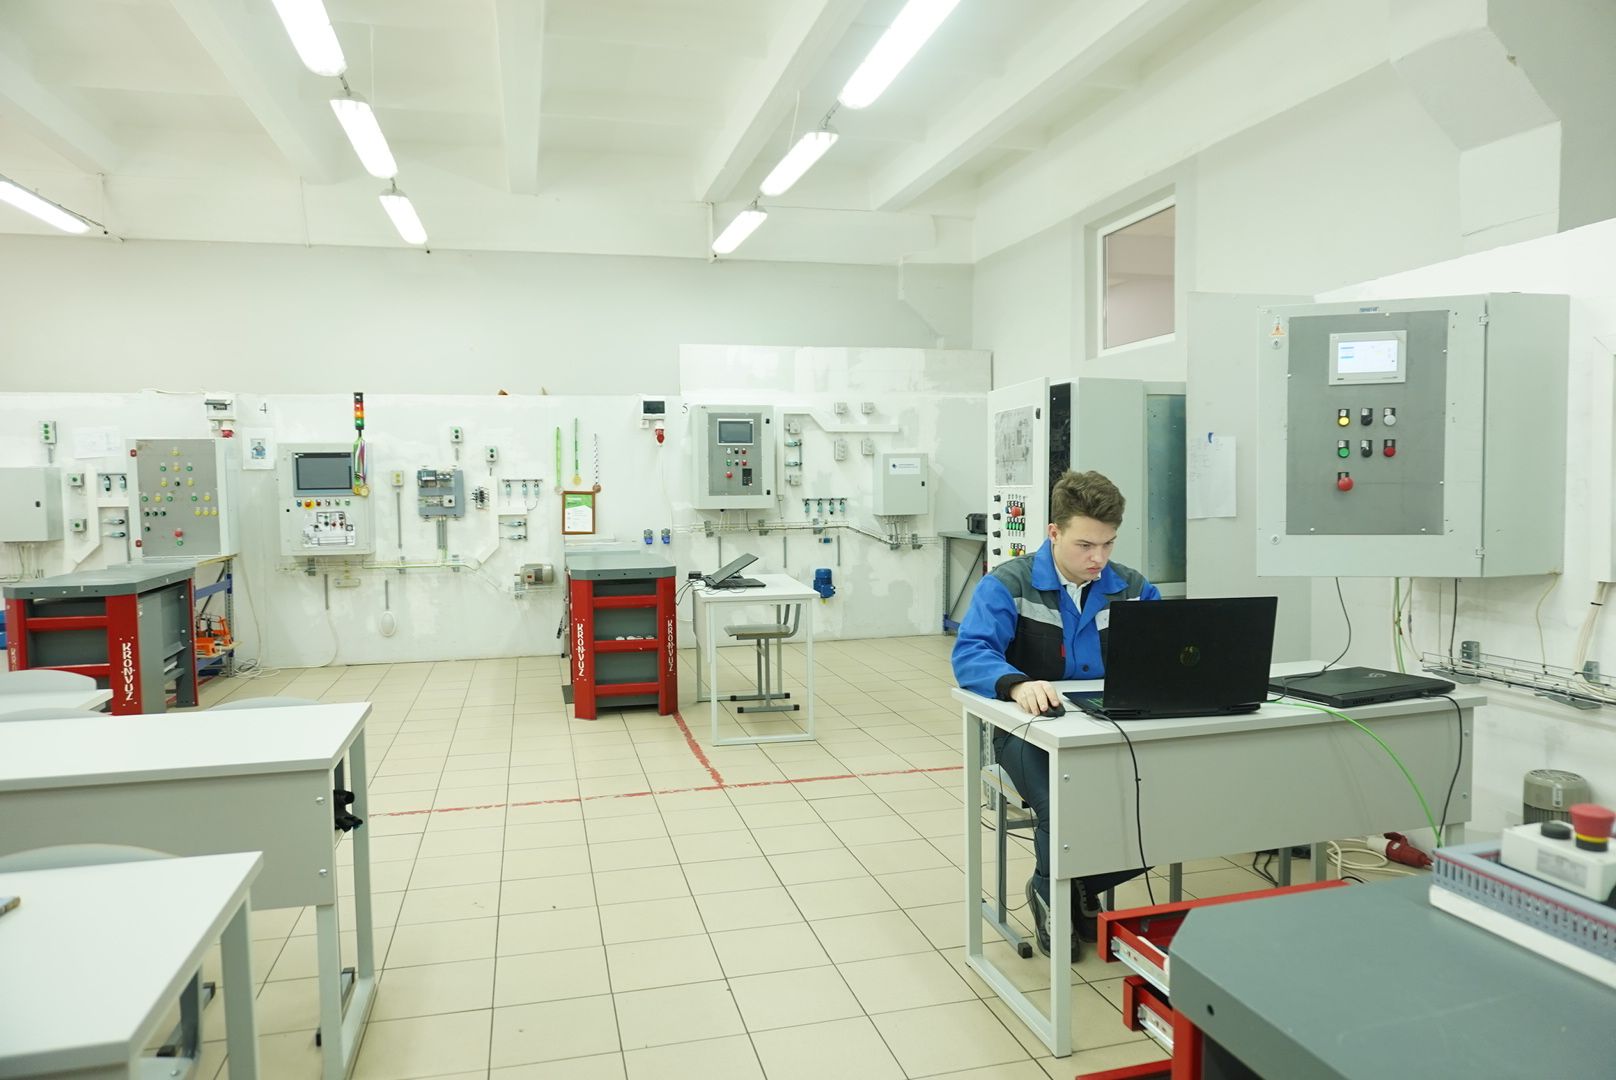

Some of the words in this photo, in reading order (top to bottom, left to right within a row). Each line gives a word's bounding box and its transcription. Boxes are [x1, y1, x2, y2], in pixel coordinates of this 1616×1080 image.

[259, 402, 268, 415] 4
[681, 402, 689, 416] 5
[122, 642, 134, 701] KRONVUZ
[577, 623, 585, 677] KRONVUZ
[667, 619, 675, 672] KRONVUZ
